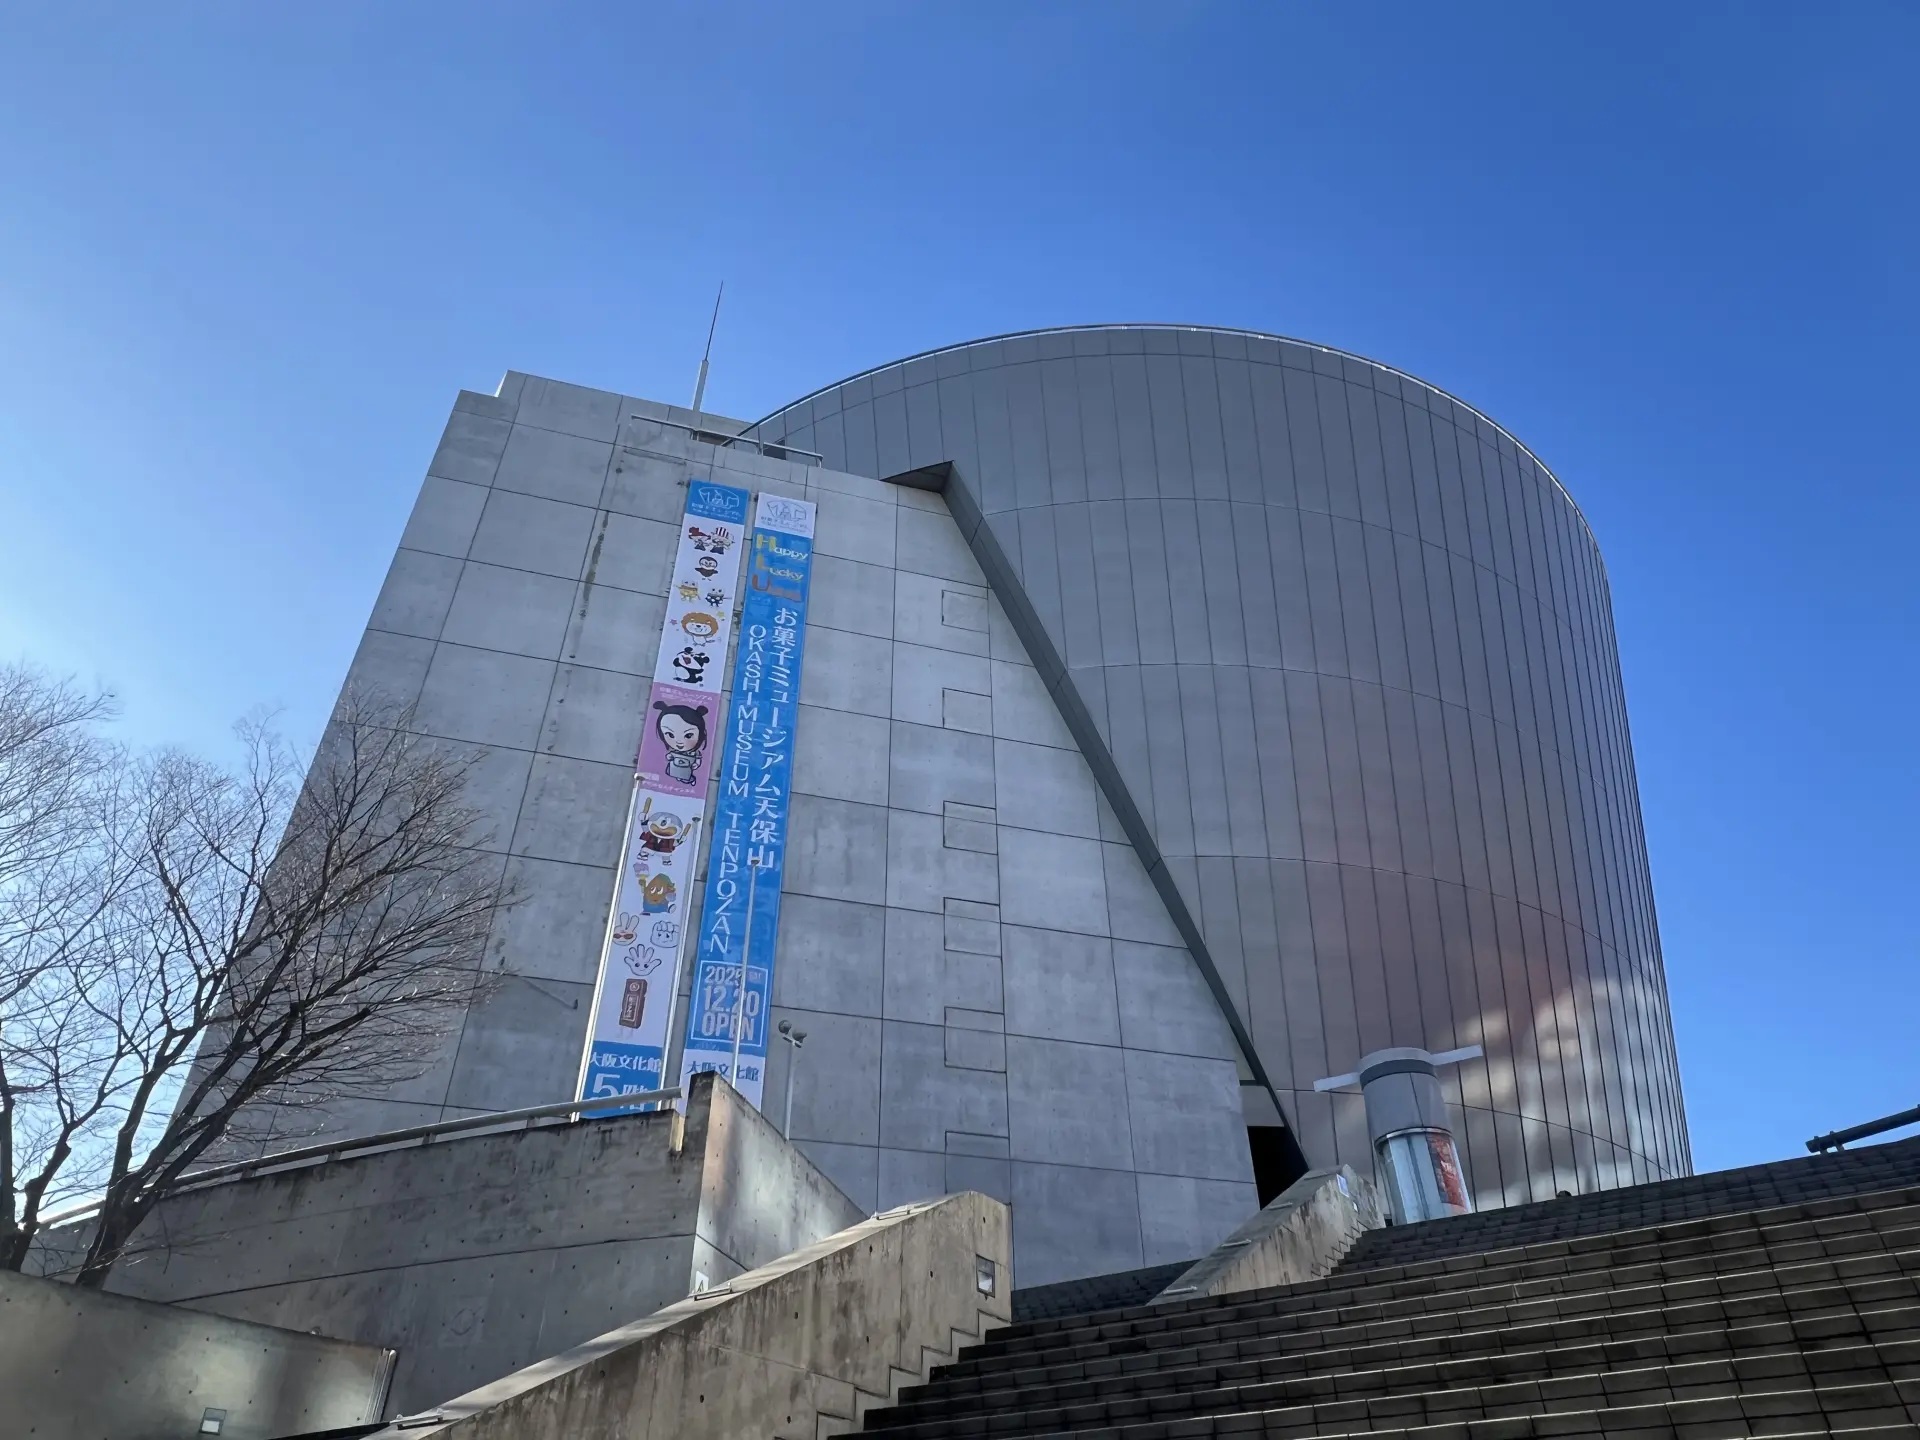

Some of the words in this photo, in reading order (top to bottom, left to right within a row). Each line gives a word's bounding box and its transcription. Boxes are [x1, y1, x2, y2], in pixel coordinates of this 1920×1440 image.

[756, 534, 808, 560] Happy
[728, 705, 758, 798] MUSEUM
[747, 607, 798, 868] お菓子ミュージアム天保山
[710, 811, 744, 954] TENPOZAN
[589, 1051, 662, 1073] 大阪文化館
